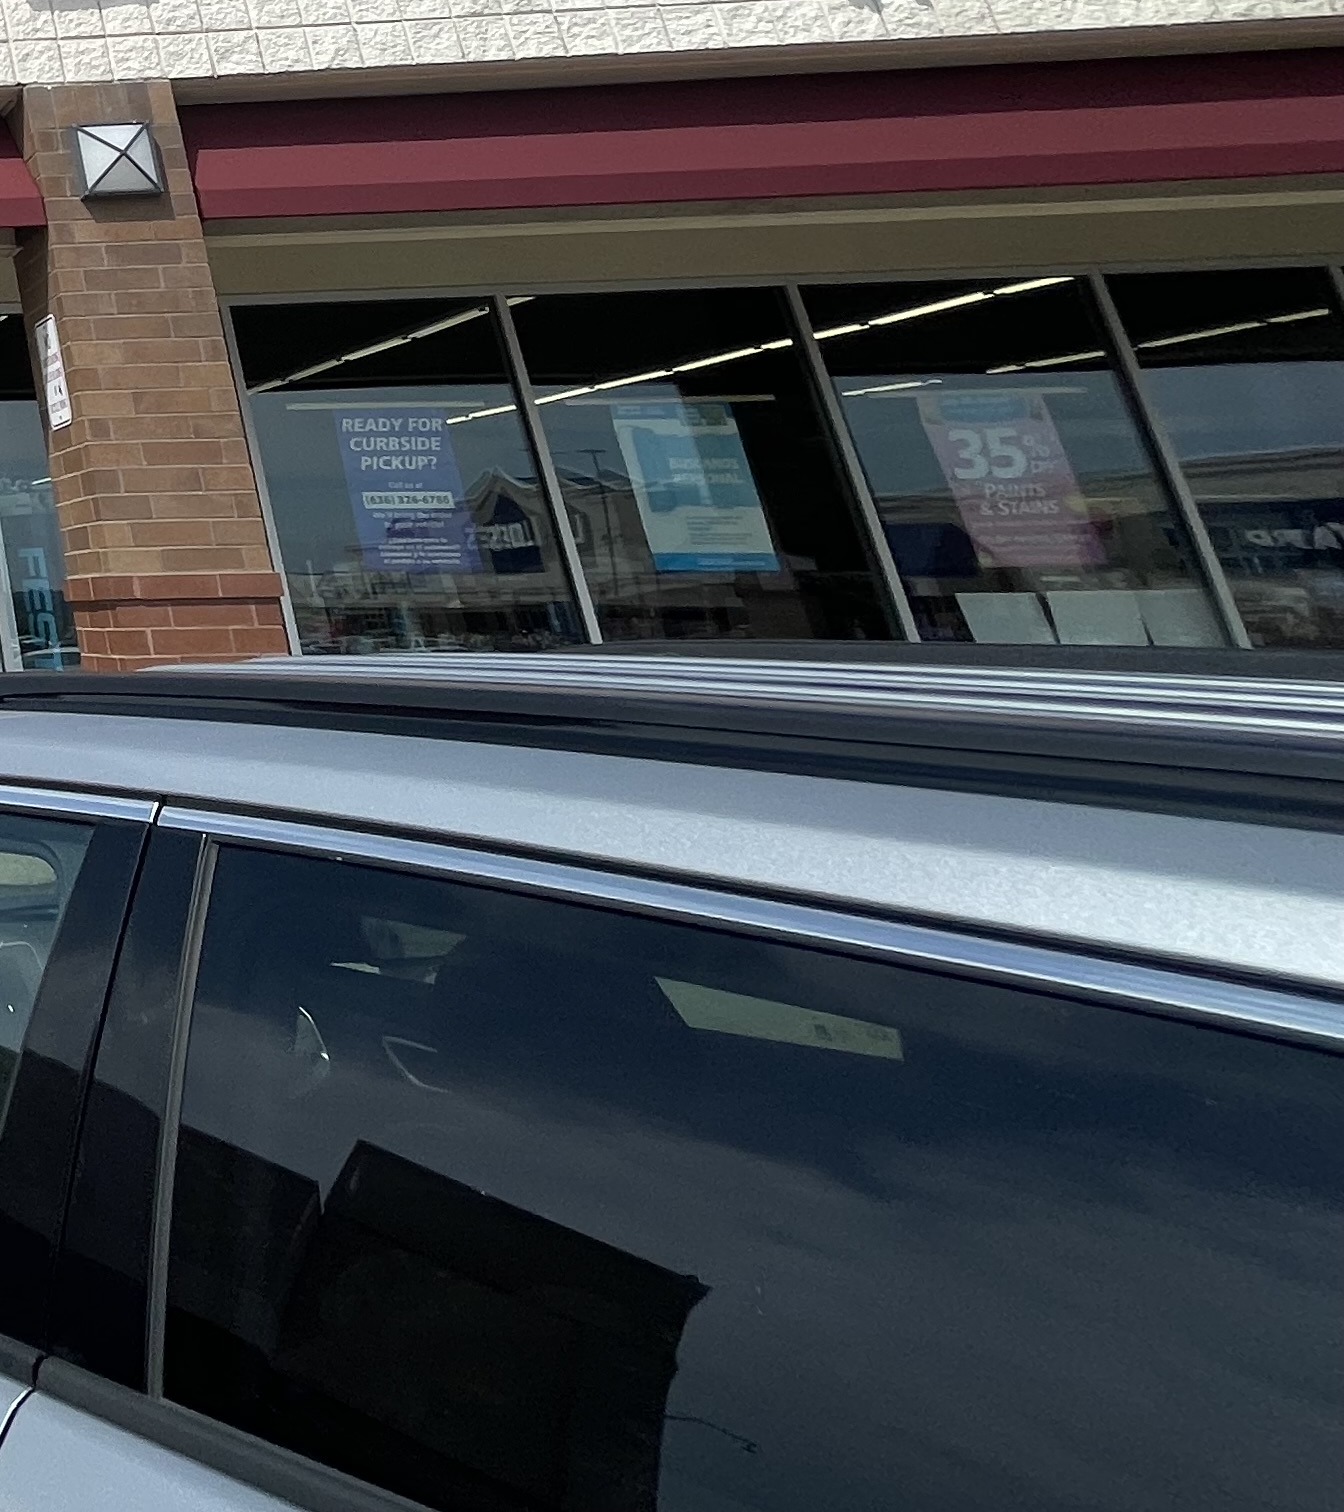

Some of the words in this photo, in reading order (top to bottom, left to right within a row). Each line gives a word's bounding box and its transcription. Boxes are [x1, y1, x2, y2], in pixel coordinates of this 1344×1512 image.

[341, 418, 403, 432] READY
[407, 418, 443, 431] FOR
[349, 436, 442, 451] CURBSIDE
[360, 455, 438, 470] PICKUP?
[984, 483, 1048, 499] PAINTS
[979, 500, 995, 516] &
[996, 499, 1060, 516] STAINS
